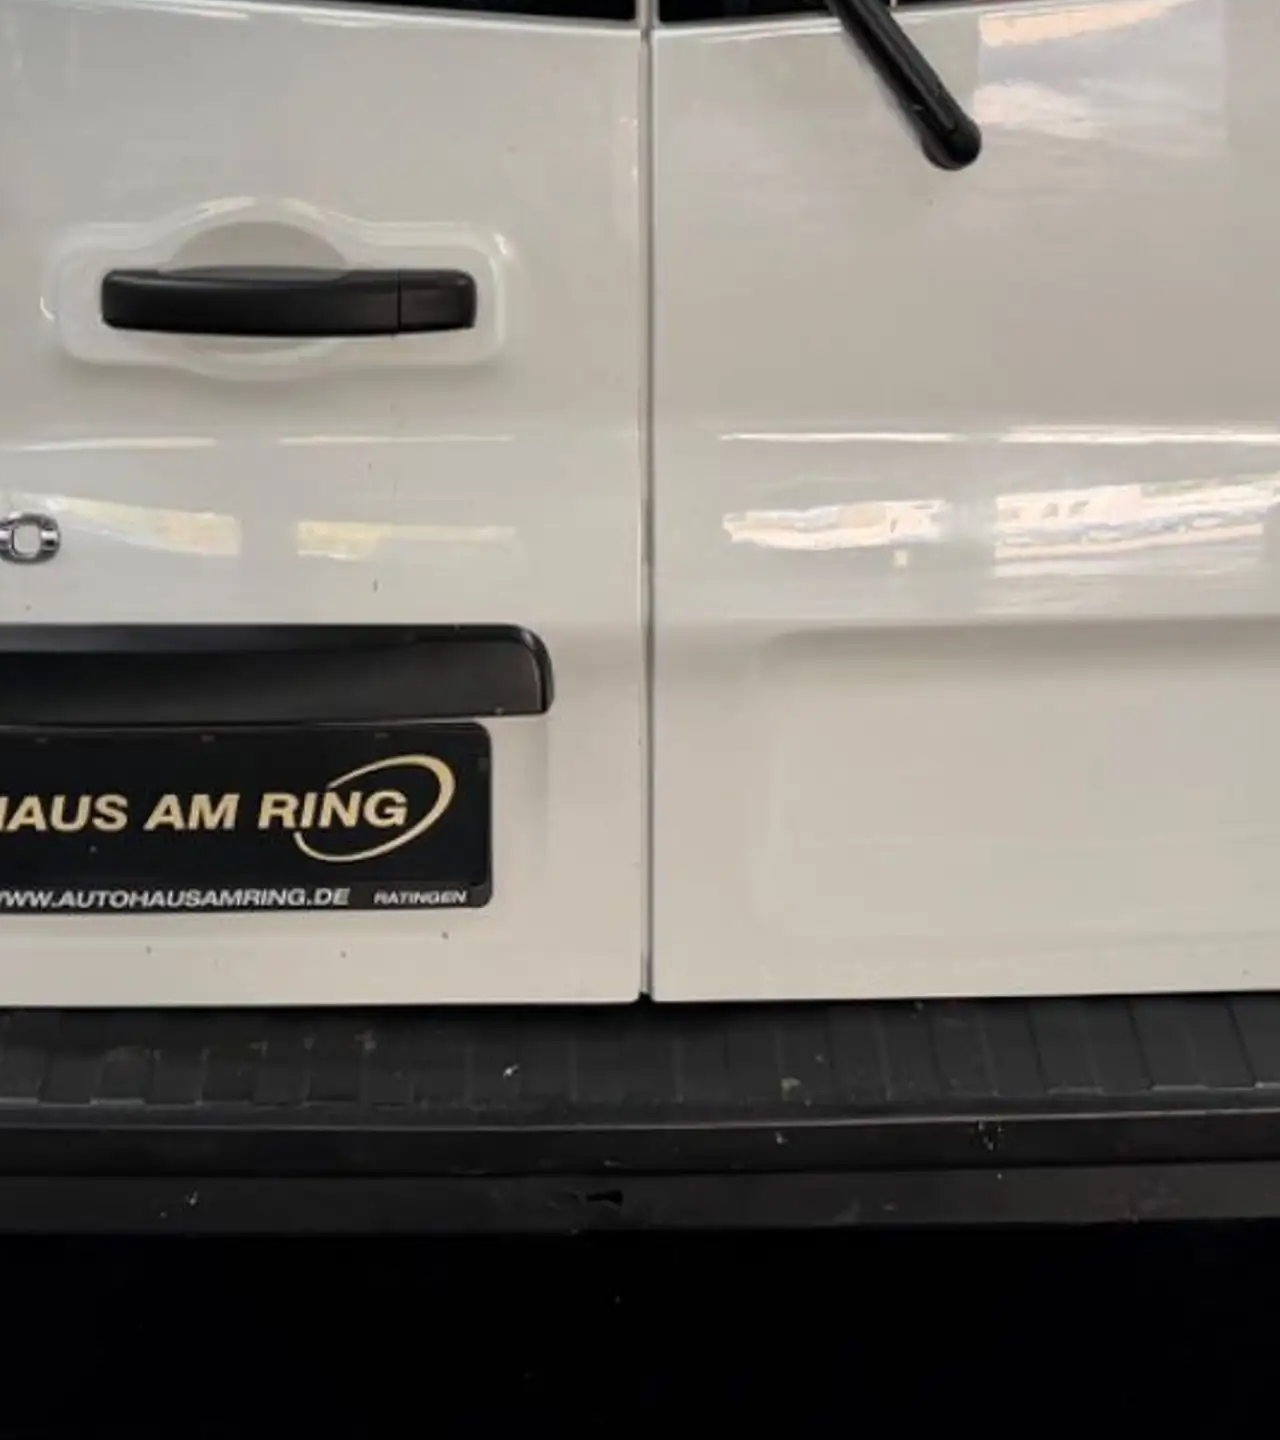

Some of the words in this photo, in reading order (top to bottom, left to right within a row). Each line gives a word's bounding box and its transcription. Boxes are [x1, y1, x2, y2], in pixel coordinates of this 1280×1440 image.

[143, 793, 239, 831] AM
[257, 790, 408, 830] RING
[373, 889, 468, 905] RATINGEN
